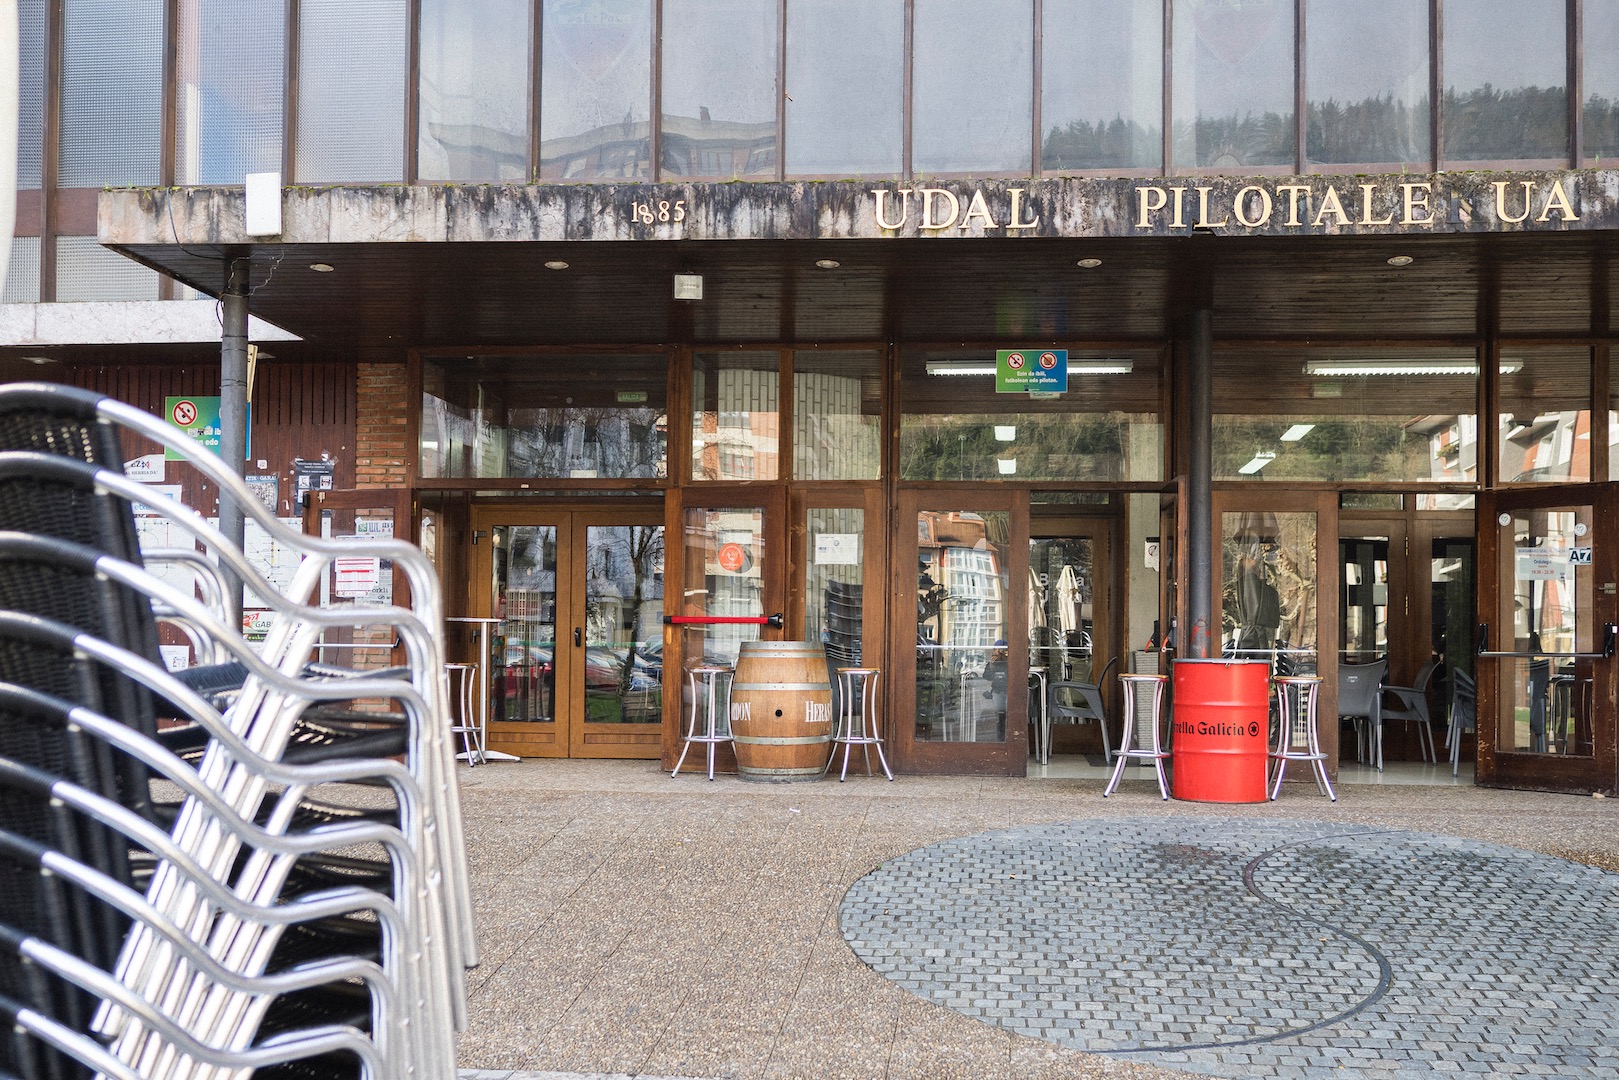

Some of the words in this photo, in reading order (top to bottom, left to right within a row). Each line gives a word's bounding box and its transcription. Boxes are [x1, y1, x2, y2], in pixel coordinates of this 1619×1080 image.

[631, 200, 685, 224] 1885
[871, 188, 1040, 230] UDAL
[205, 438, 219, 446] edo
[1197, 721, 1244, 736] Galicia
